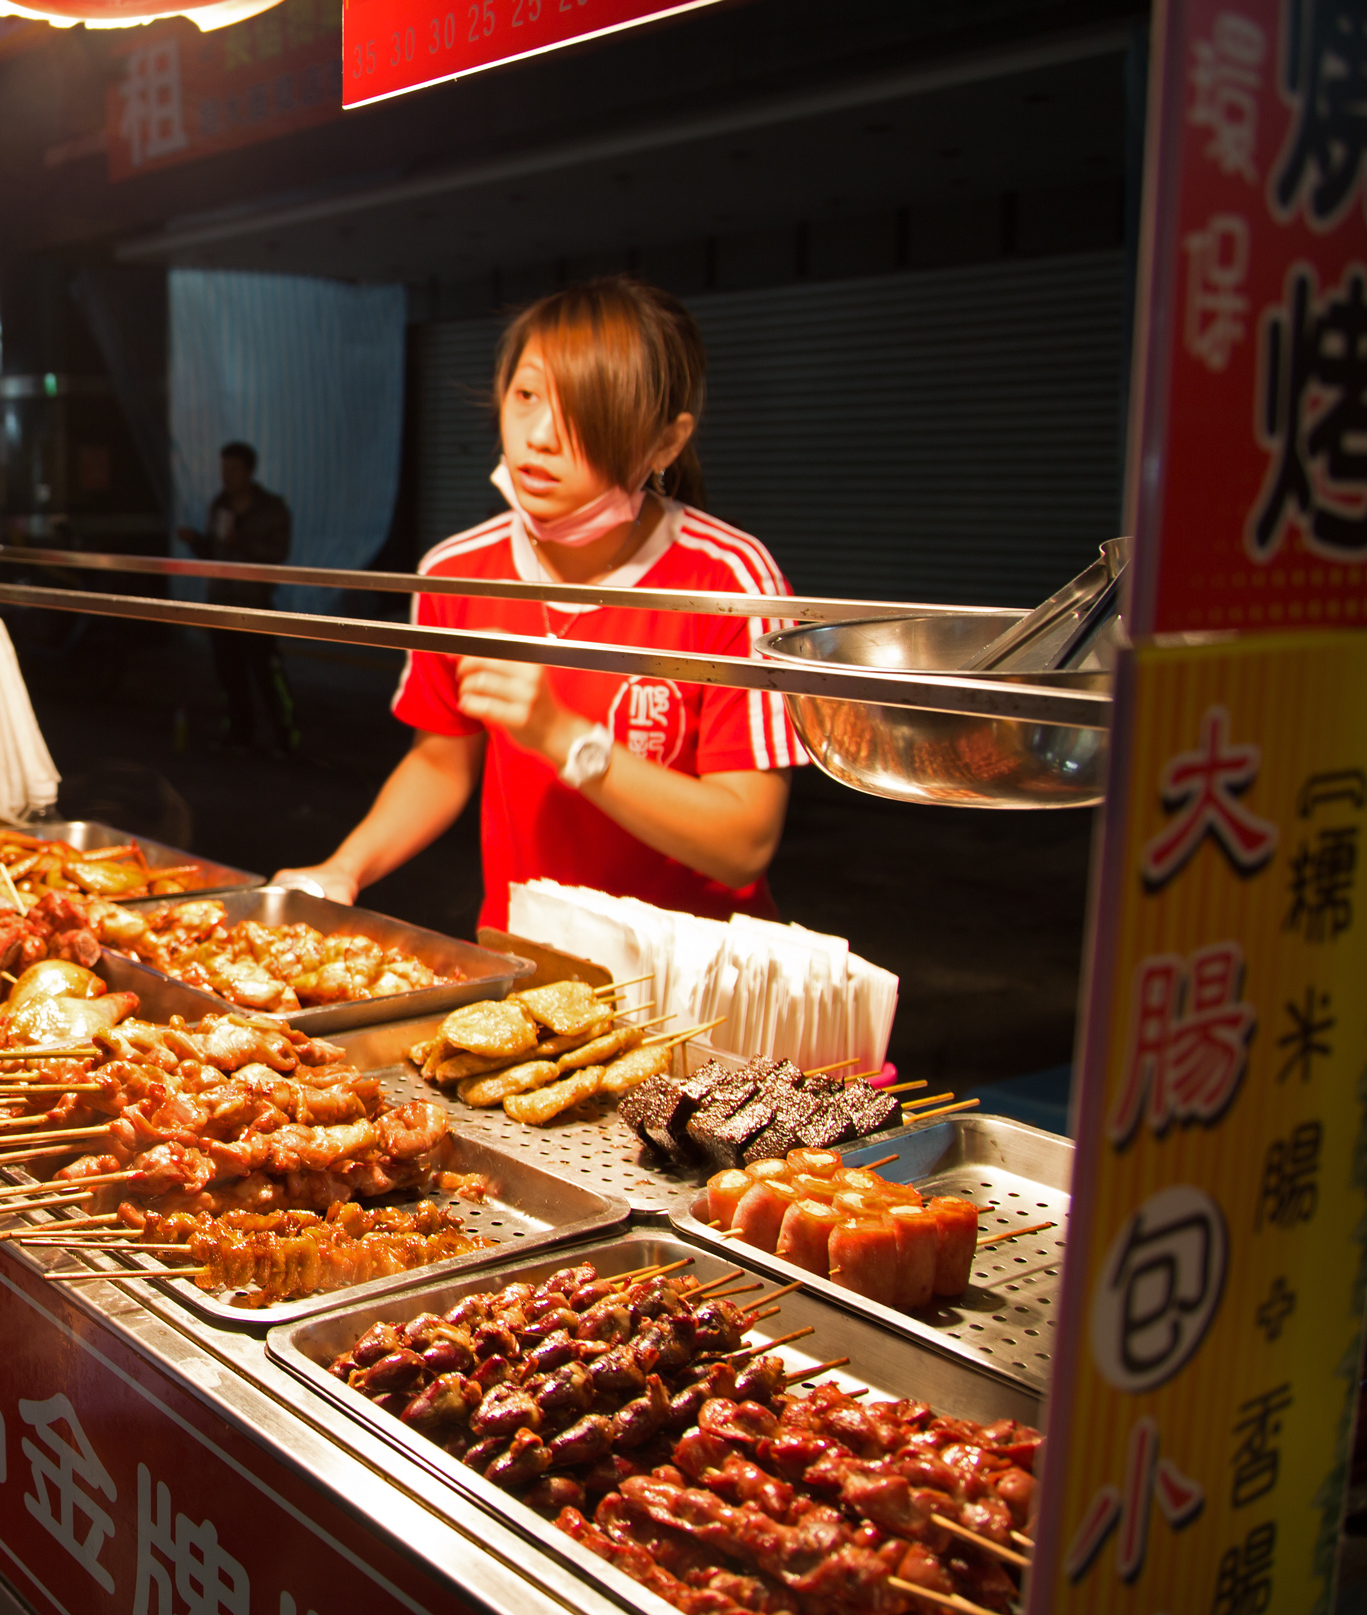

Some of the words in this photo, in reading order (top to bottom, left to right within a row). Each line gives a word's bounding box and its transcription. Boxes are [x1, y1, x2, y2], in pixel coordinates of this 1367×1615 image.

[352, 39, 377, 79] 35
[390, 26, 416, 67] 30
[429, 12, 456, 54] 30
[467, 3, 496, 43] 25
[119, 38, 190, 167] 租
